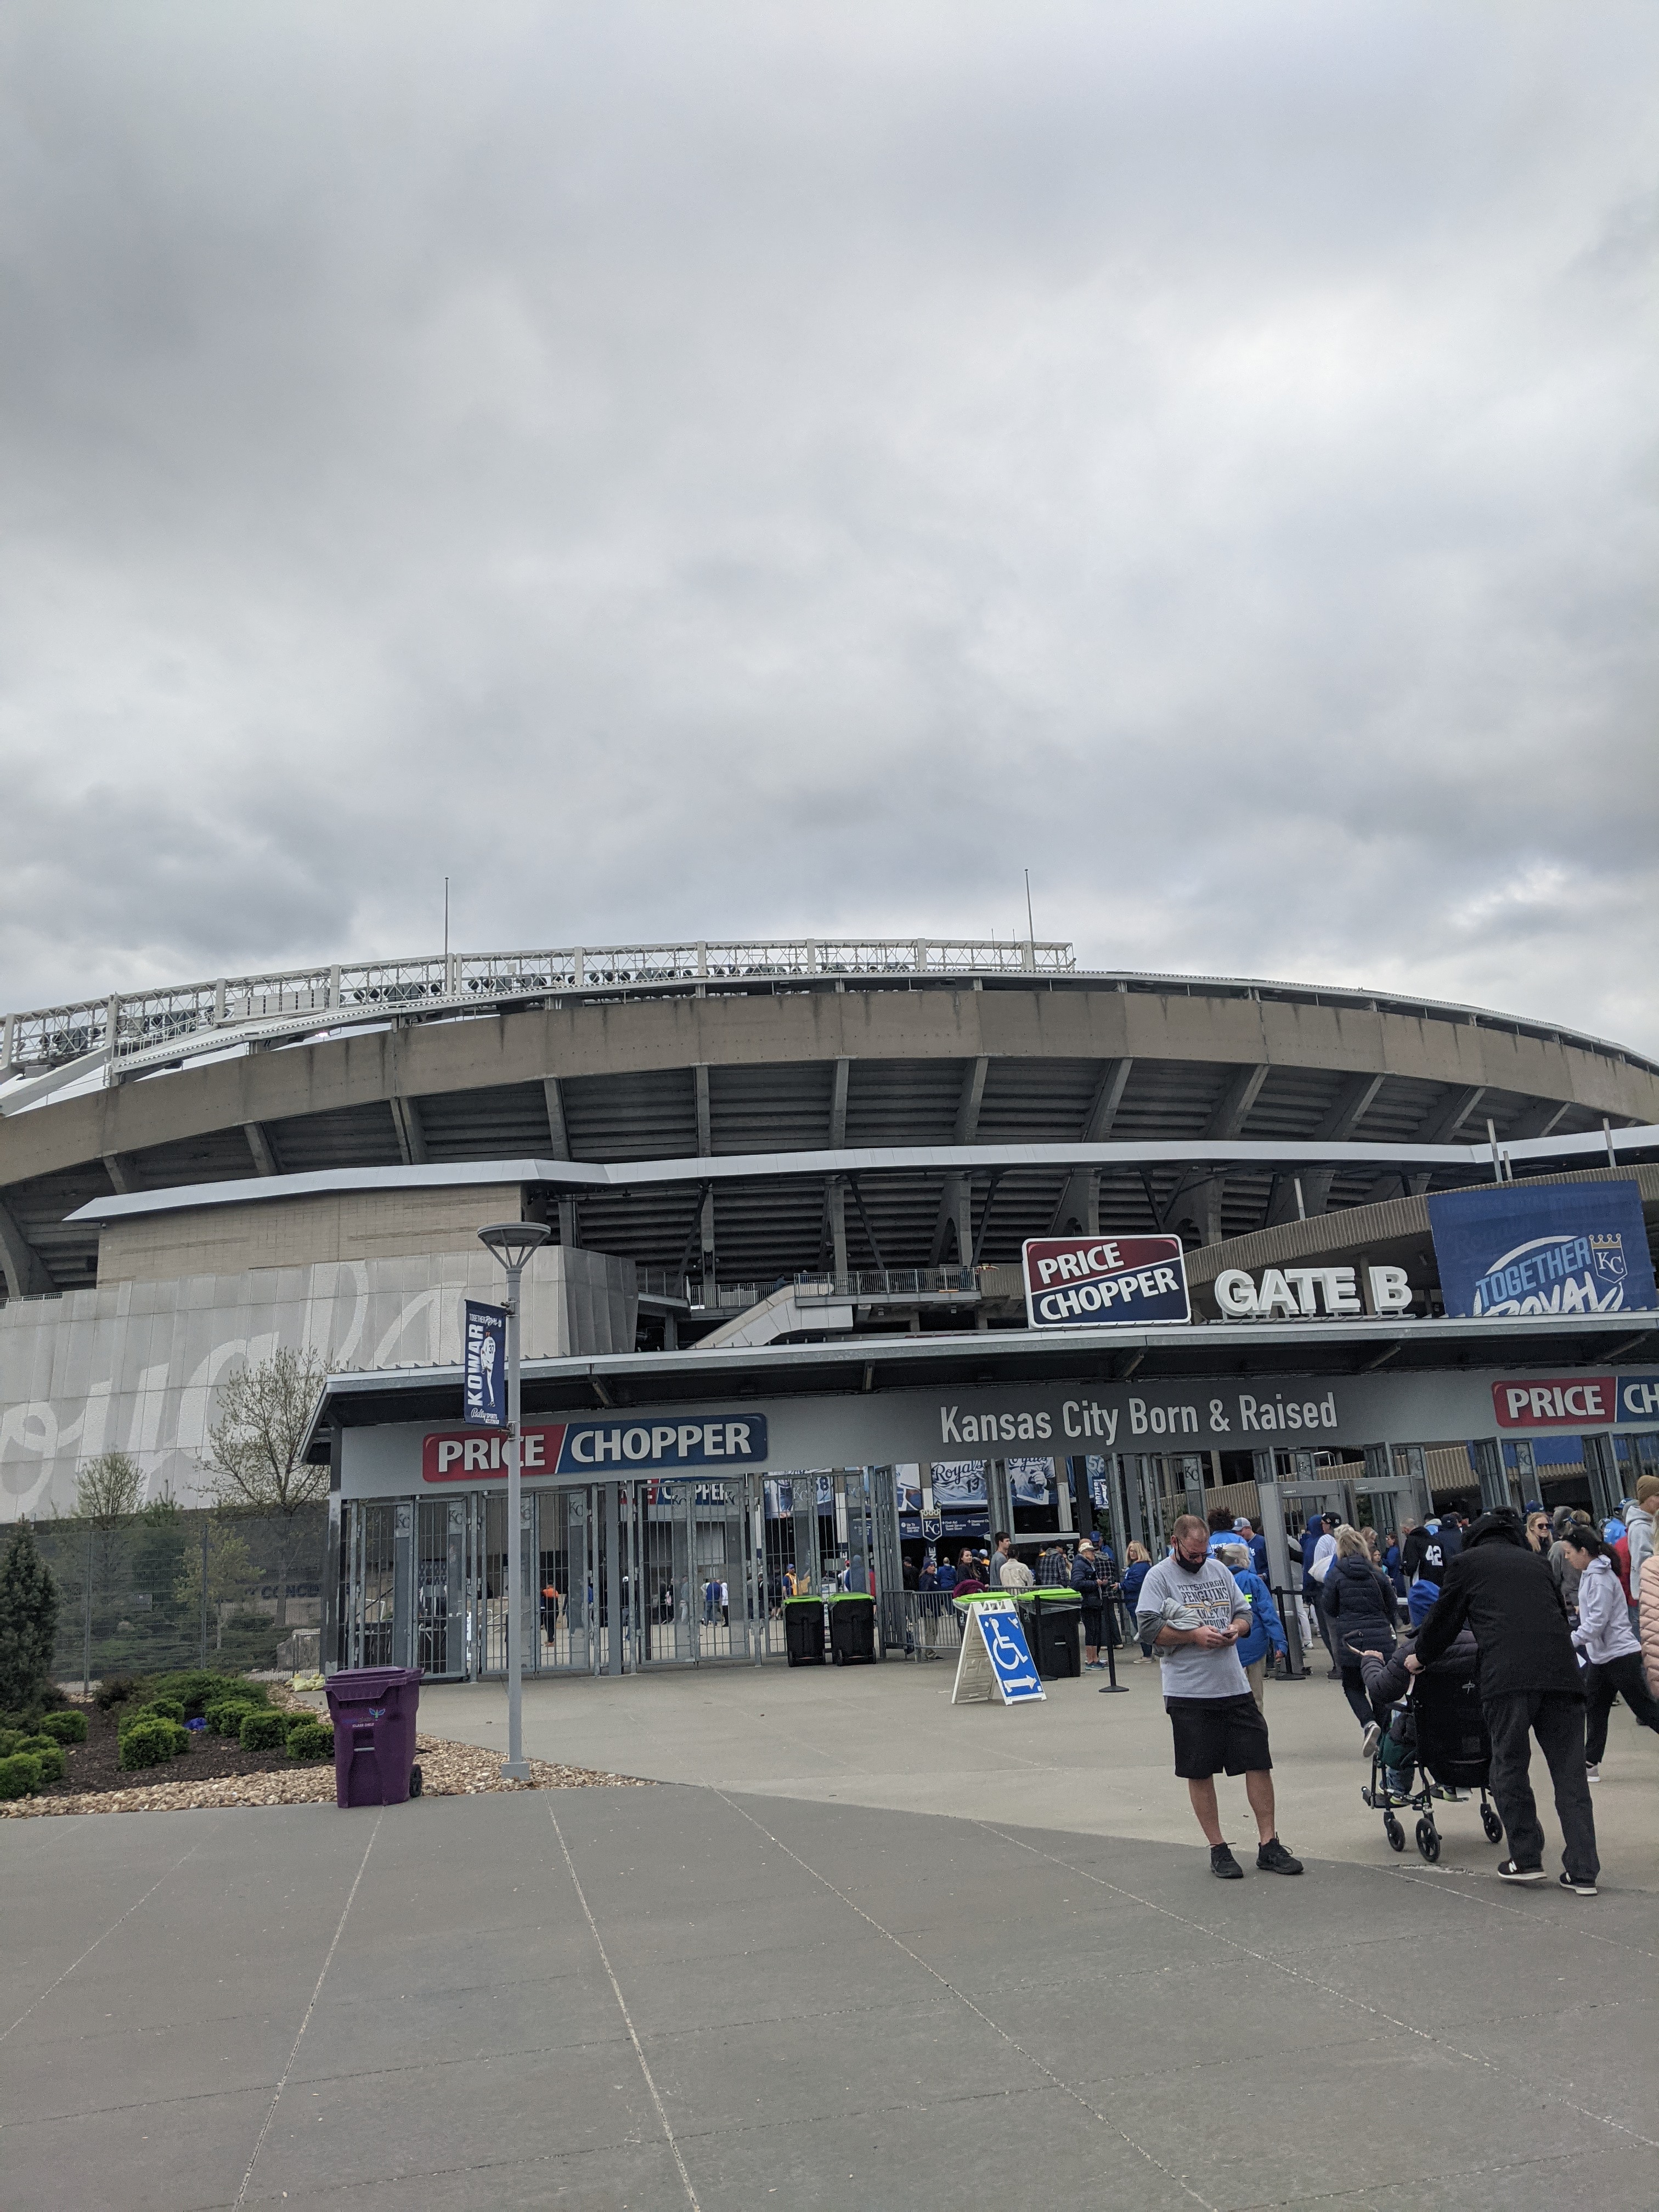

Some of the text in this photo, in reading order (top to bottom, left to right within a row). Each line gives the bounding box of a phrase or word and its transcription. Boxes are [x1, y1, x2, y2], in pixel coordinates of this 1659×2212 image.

[1037, 1242, 1124, 1284] PRICE
[1476, 1237, 1592, 1307] TOGETHER
[1595, 1252, 1623, 1274] KC
[1040, 1267, 1180, 1320] CHOPPER
[1215, 1266, 1412, 1316] GATE B
[469, 1313, 486, 1324] TOGETHER
[467, 1324, 484, 1406] KOWAR
[471, 1407, 486, 1421] Bally
[1506, 1385, 1605, 1418] PRICE
[940, 1392, 1338, 1445] Kansas City Born & Raised
[571, 1423, 752, 1463] CHOPPER
[932, 1459, 985, 1485] Royals
[967, 1477, 979, 1493] 13
[924, 1520, 940, 1535] KC
[1425, 1545, 1443, 1566] 42
[1177, 1579, 1225, 1591] PITTSBURGH
[1181, 1587, 1229, 1603] PENGUINS
